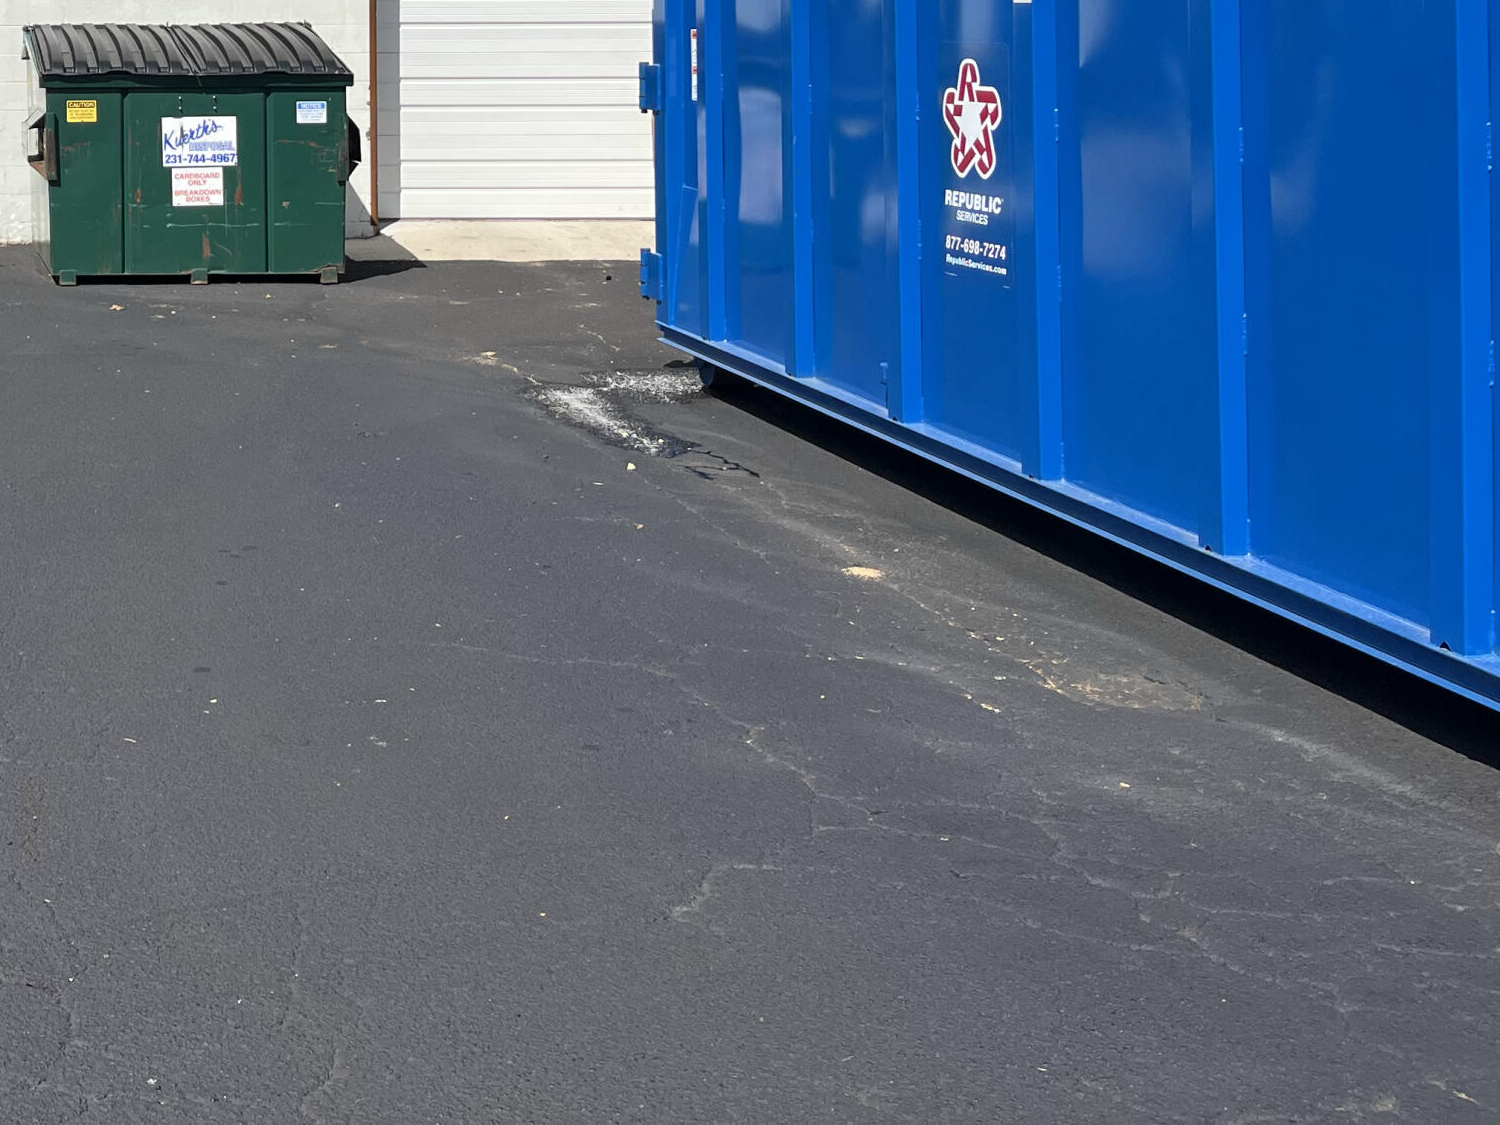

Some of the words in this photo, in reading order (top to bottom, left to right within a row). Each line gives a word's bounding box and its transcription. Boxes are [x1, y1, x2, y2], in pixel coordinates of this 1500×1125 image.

[189, 141, 236, 151] DISPOSAL
[165, 153, 236, 164] 231-744-4967
[174, 188, 222, 196] BREAKDOWN
[944, 189, 1002, 214] REPUBLIC
[956, 209, 988, 226] SERVICES
[945, 234, 1006, 260] 877-698-7274
[945, 253, 1007, 275] RepublicServices.com
